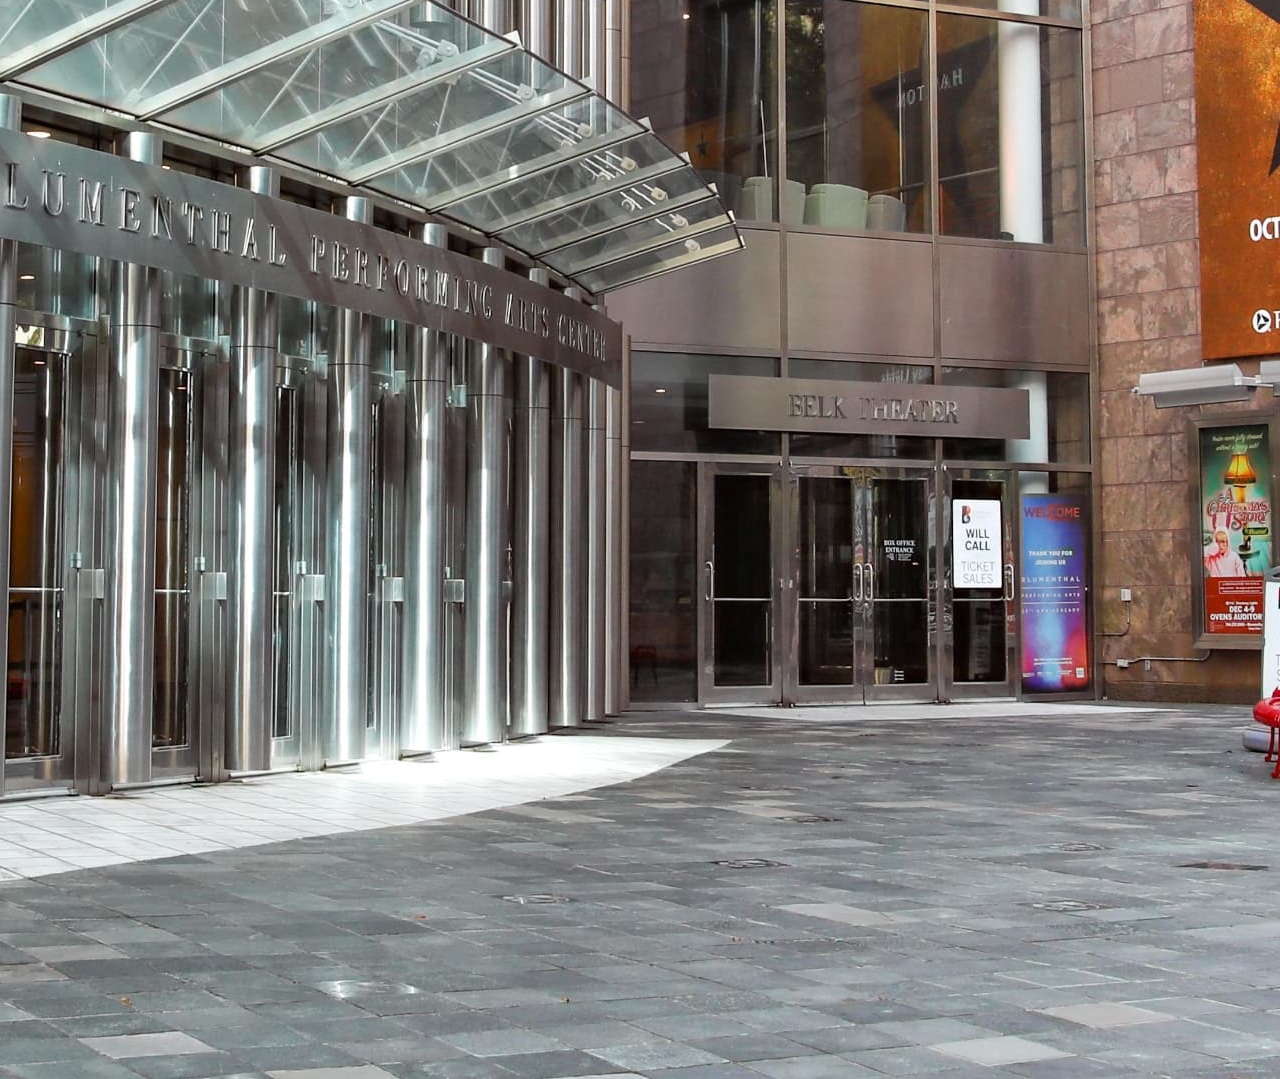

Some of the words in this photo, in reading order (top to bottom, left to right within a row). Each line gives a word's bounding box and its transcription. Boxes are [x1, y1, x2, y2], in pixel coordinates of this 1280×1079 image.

[310, 234, 493, 318] PERFORMING
[504, 292, 550, 337] ARTS
[557, 313, 608, 361] CENTER
[789, 393, 846, 419] BELK
[858, 396, 960, 425] THEATER
[1024, 506, 1081, 519] WELCOME
[965, 528, 990, 539] WILL
[896, 539, 916, 547] OFFICE
[965, 540, 991, 551] CALL
[961, 561, 995, 572] TICKET
[962, 573, 994, 584] SALES
[1229, 605, 1242, 613] DEC
[1210, 613, 1232, 621] OVENS
